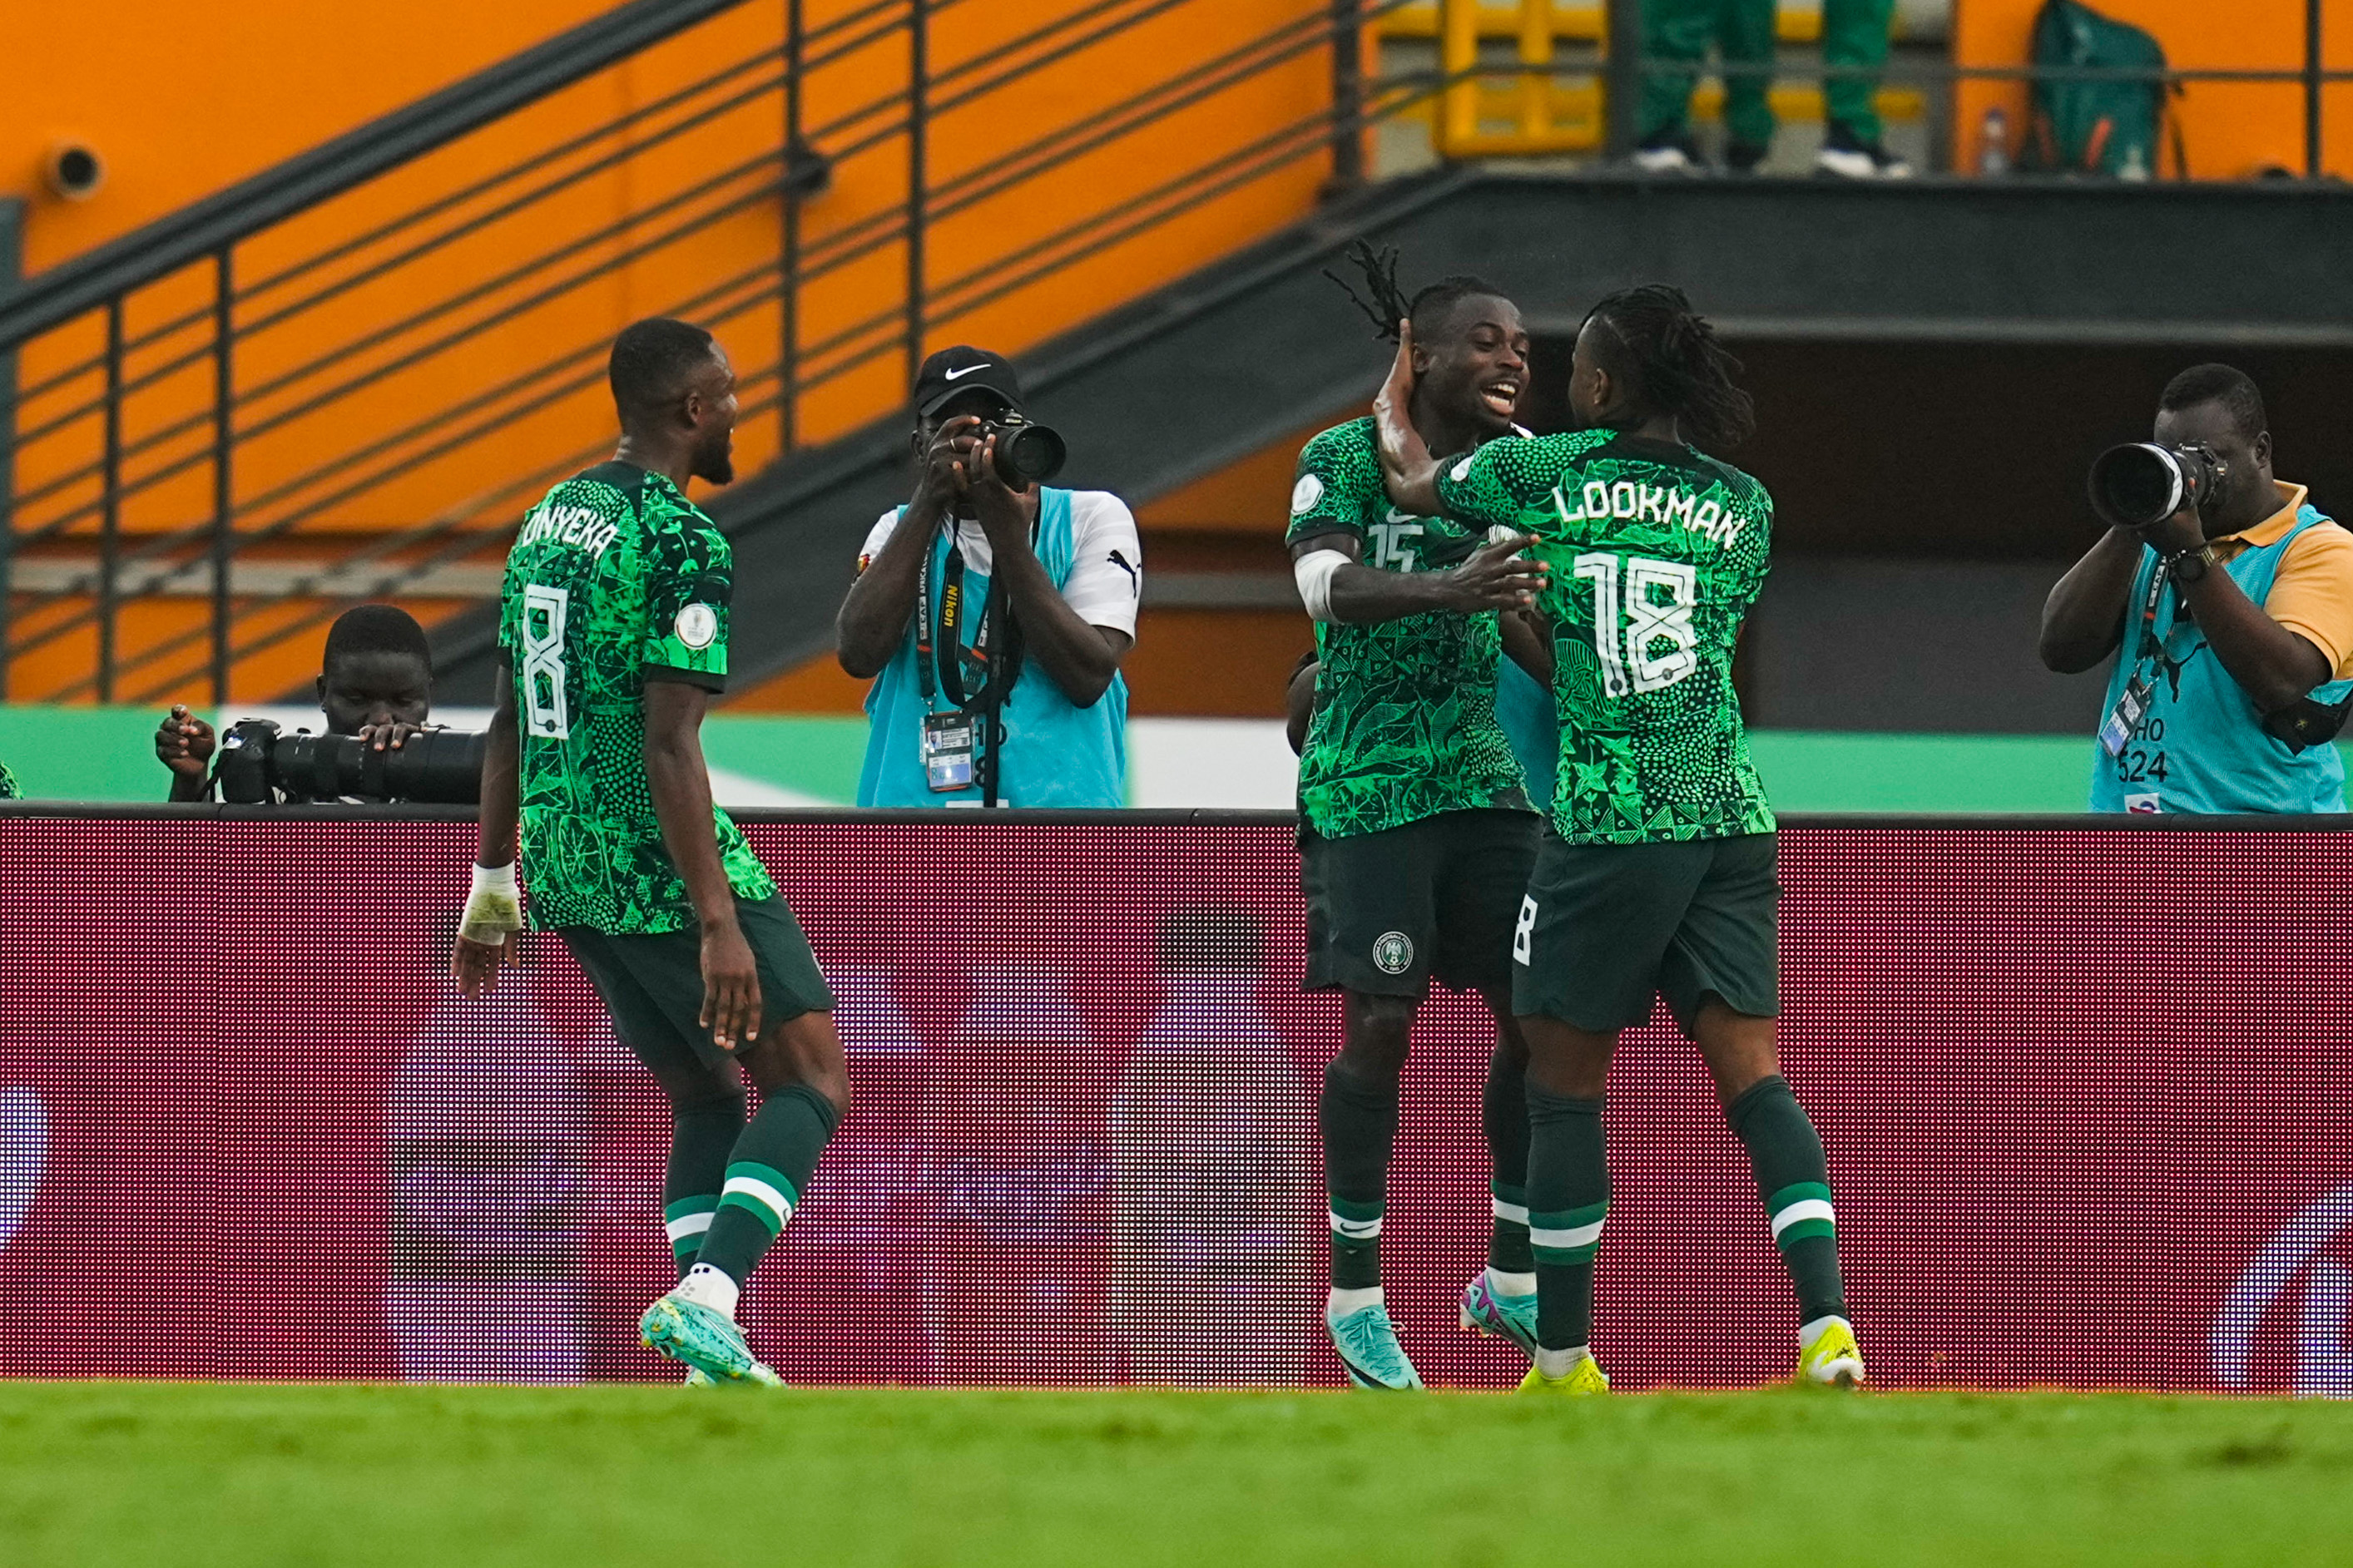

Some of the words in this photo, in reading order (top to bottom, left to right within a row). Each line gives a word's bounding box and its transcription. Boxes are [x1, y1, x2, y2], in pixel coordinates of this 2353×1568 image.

[523, 506, 619, 560] ONYEKA
[1552, 480, 1746, 550] LOOKMAN
[1368, 523, 1424, 573] 15
[944, 585, 959, 627] Nikon
[1573, 552, 1697, 698] 18
[523, 583, 569, 739] 8
[2133, 718, 2164, 741] HO
[2118, 750, 2168, 783] 524
[1513, 893, 1539, 967] 8
